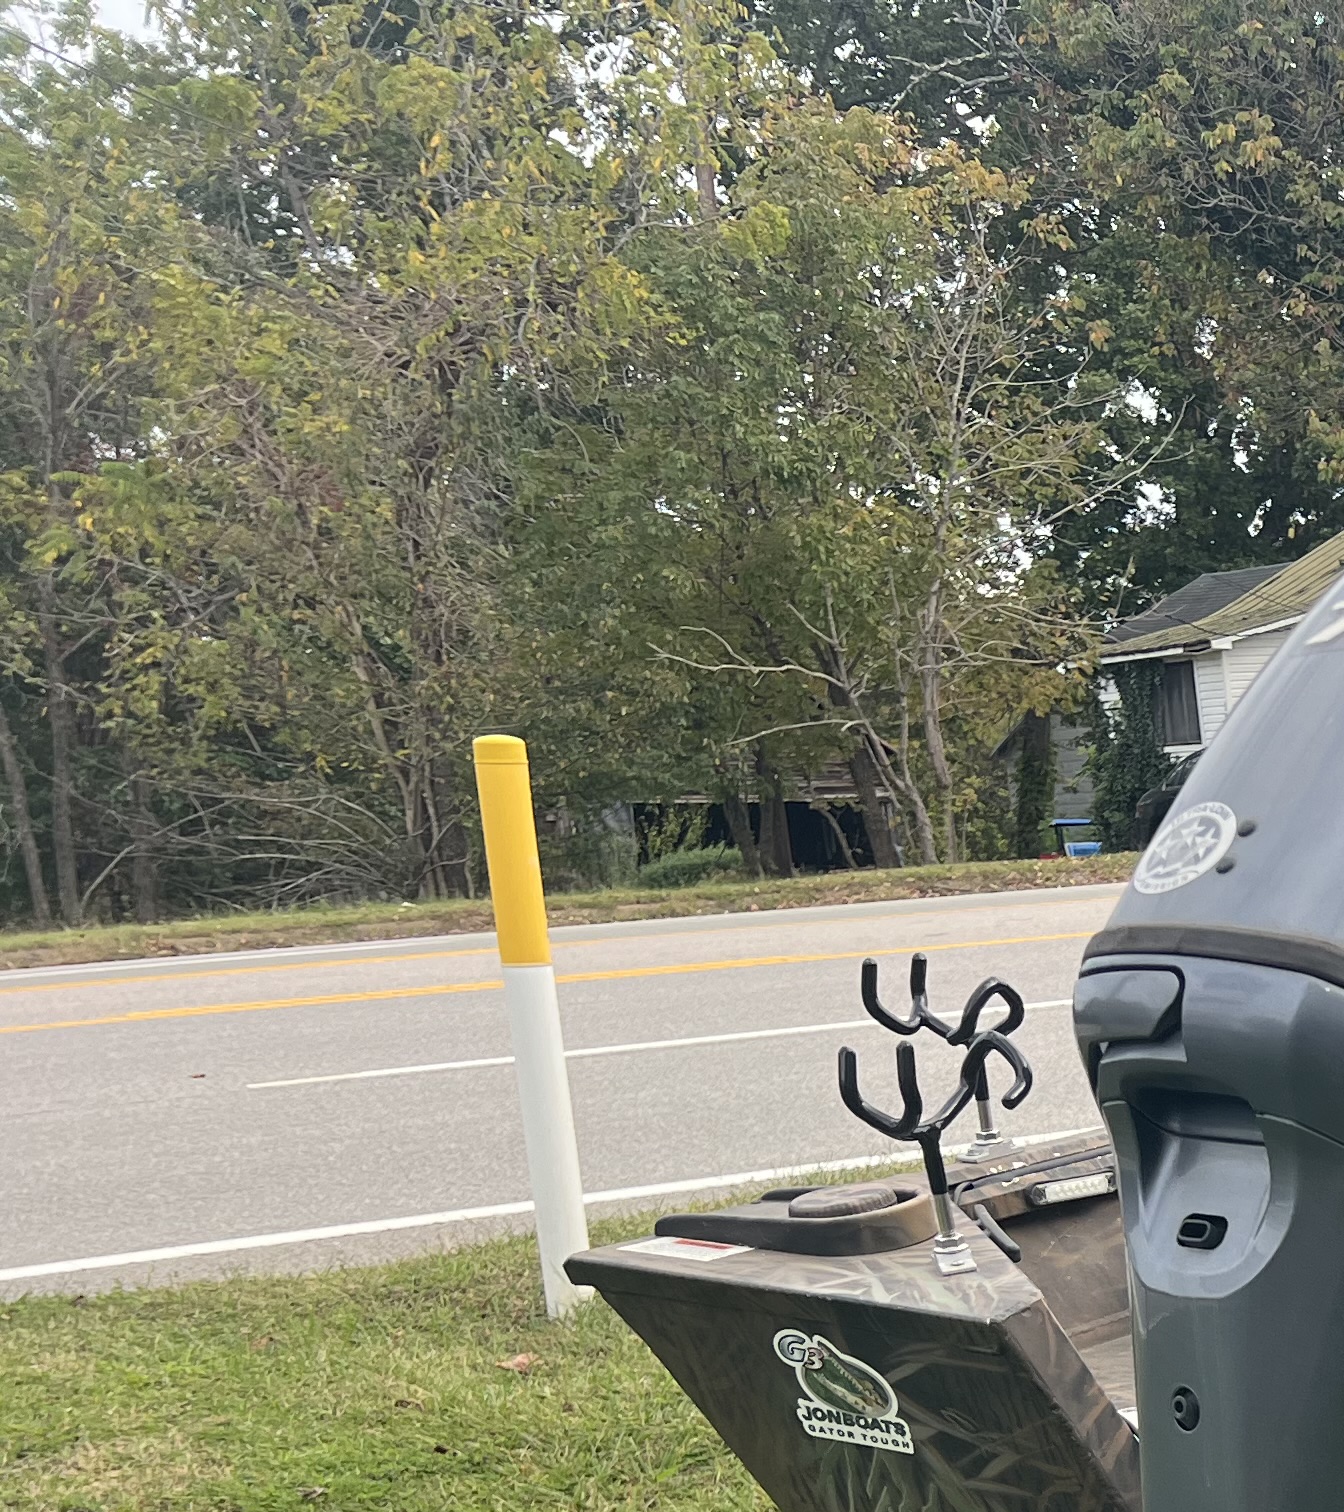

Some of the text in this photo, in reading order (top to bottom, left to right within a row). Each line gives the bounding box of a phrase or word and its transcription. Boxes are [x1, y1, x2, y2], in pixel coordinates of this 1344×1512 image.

[777, 1334, 825, 1370] G3
[801, 1404, 907, 1438] JONBOATS
[808, 1423, 911, 1449] GATOR TOUGH
